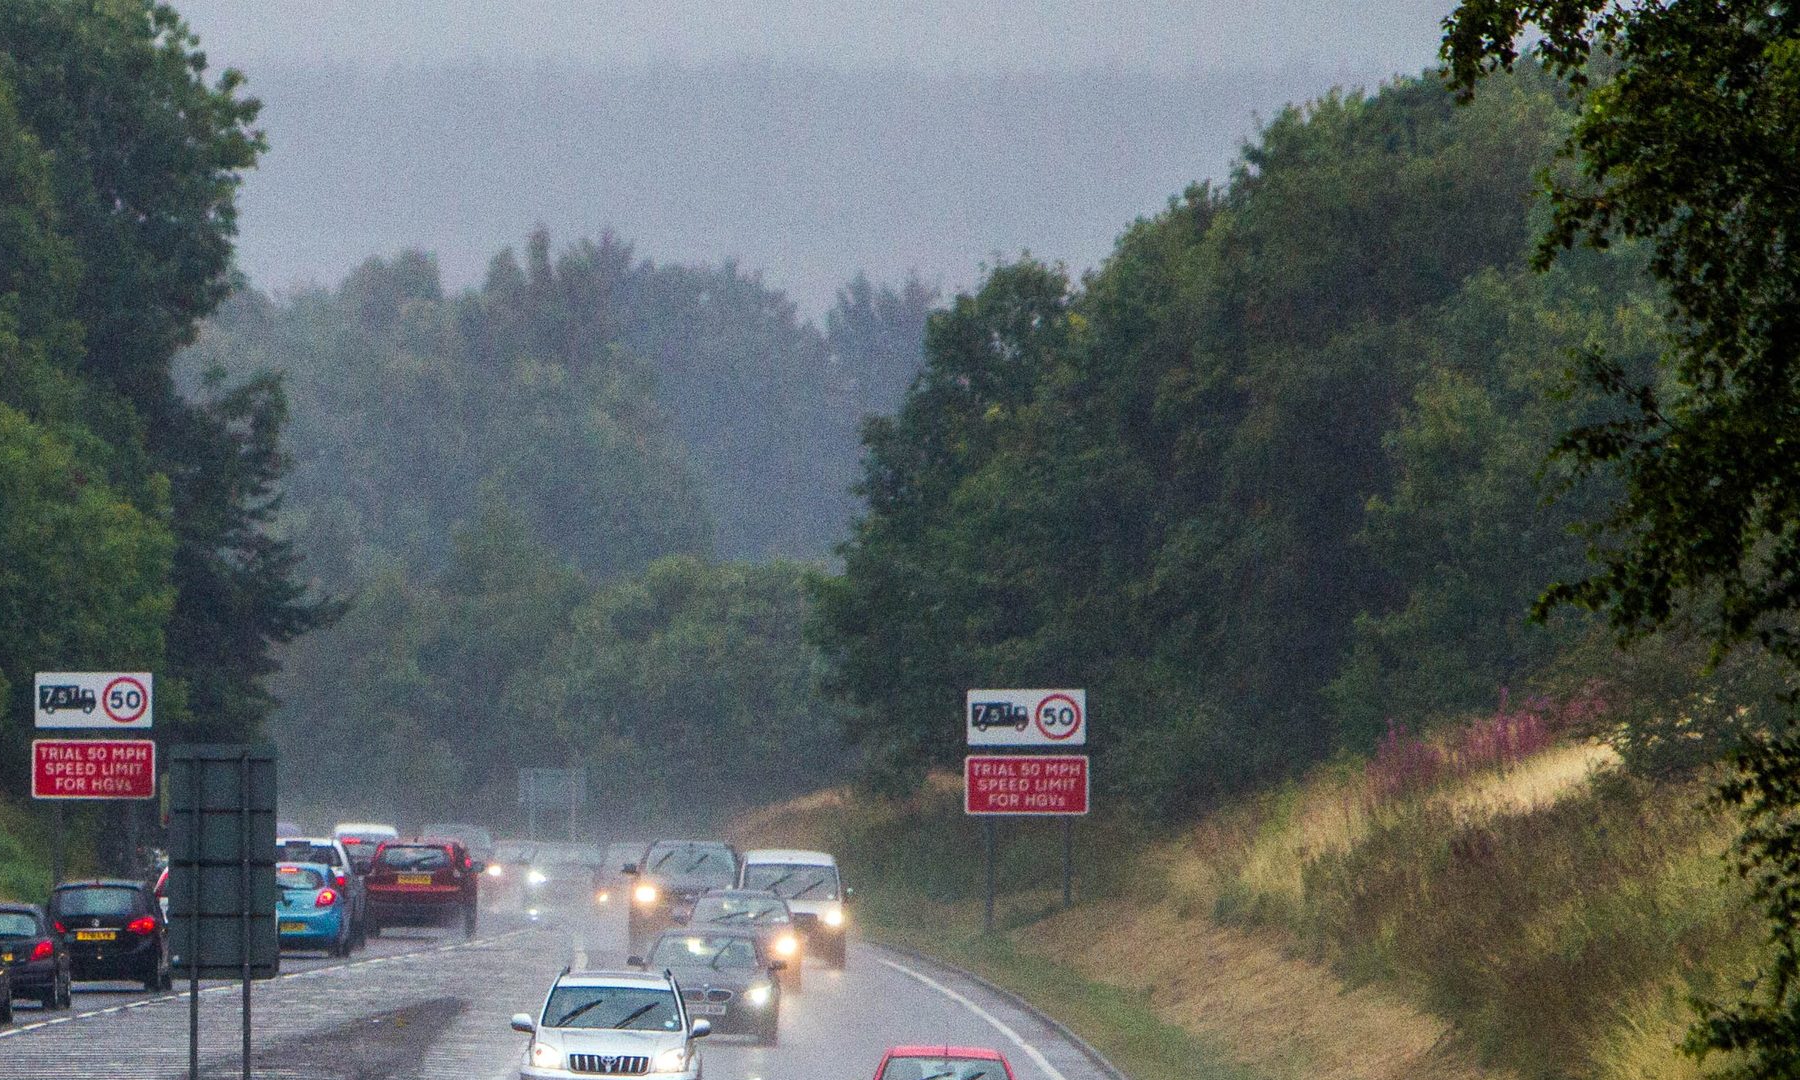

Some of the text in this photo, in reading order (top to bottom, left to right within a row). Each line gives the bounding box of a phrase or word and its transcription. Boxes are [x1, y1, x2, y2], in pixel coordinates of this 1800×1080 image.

[110, 690, 141, 709] 50
[1042, 706, 1075, 726] 50
[39, 747, 147, 760] TRIAL 50 MPH
[45, 763, 142, 775] SPEED LIMIT
[974, 763, 1081, 776] TRIAL 50 MPH
[55, 778, 132, 791] FOR HGVs
[977, 779, 1076, 792] SPEED LIMIT
[988, 794, 1019, 806] FOR
